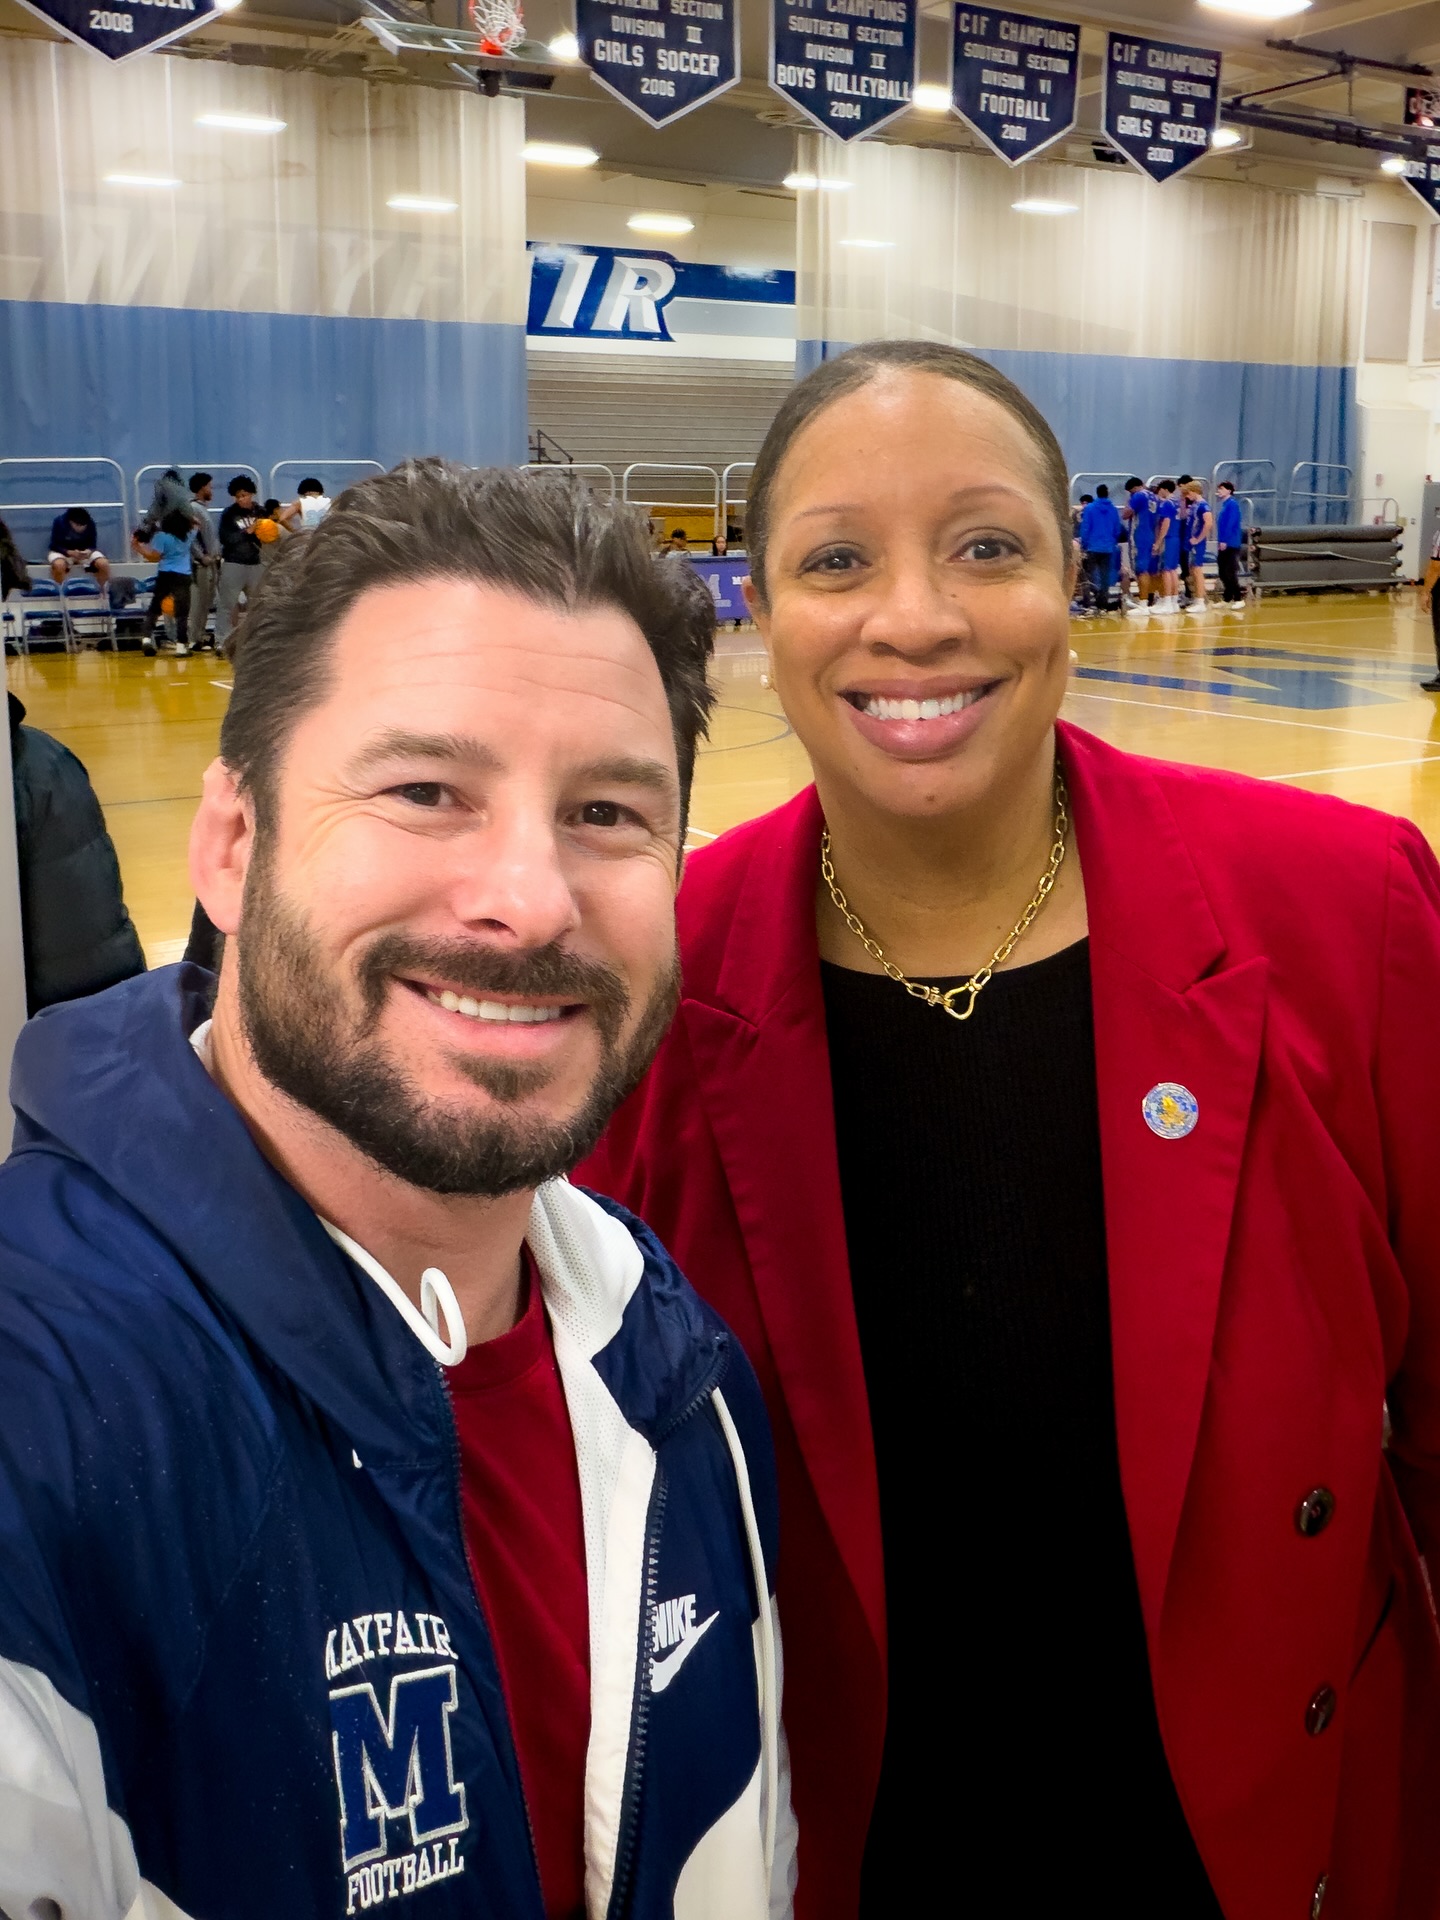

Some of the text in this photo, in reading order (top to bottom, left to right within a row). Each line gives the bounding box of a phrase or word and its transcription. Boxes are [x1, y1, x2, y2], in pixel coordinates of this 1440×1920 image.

[89, 9, 134, 33] 2008
[670, 0, 724, 20] SECTION
[611, 15, 666, 39] DIVISION
[788, 15, 904, 46] SOUTHERN SECTION
[960, 12, 1076, 51] CIF CHAMPIONS
[593, 38, 720, 77] GIRLS SOCCER
[805, 42, 854, 65] DIVISION
[963, 42, 1069, 74] SOUTHERN SECTION
[1113, 41, 1217, 77] CIF CHAMPIONS
[640, 77, 676, 97] 2006
[776, 63, 912, 102] BOYS VOLLEYBALL
[982, 69, 1025, 90] DIVISION
[1116, 70, 1211, 99] SOUTHERN SECTION
[829, 101, 862, 120] 2004
[980, 92, 1051, 122] FOOTBALL
[1117, 115, 1207, 146] GIRLS SOCCER
[651, 1593, 697, 1653] NIKE
[329, 1664, 470, 1874] M
[346, 1838, 465, 1915] FOOTBALL
